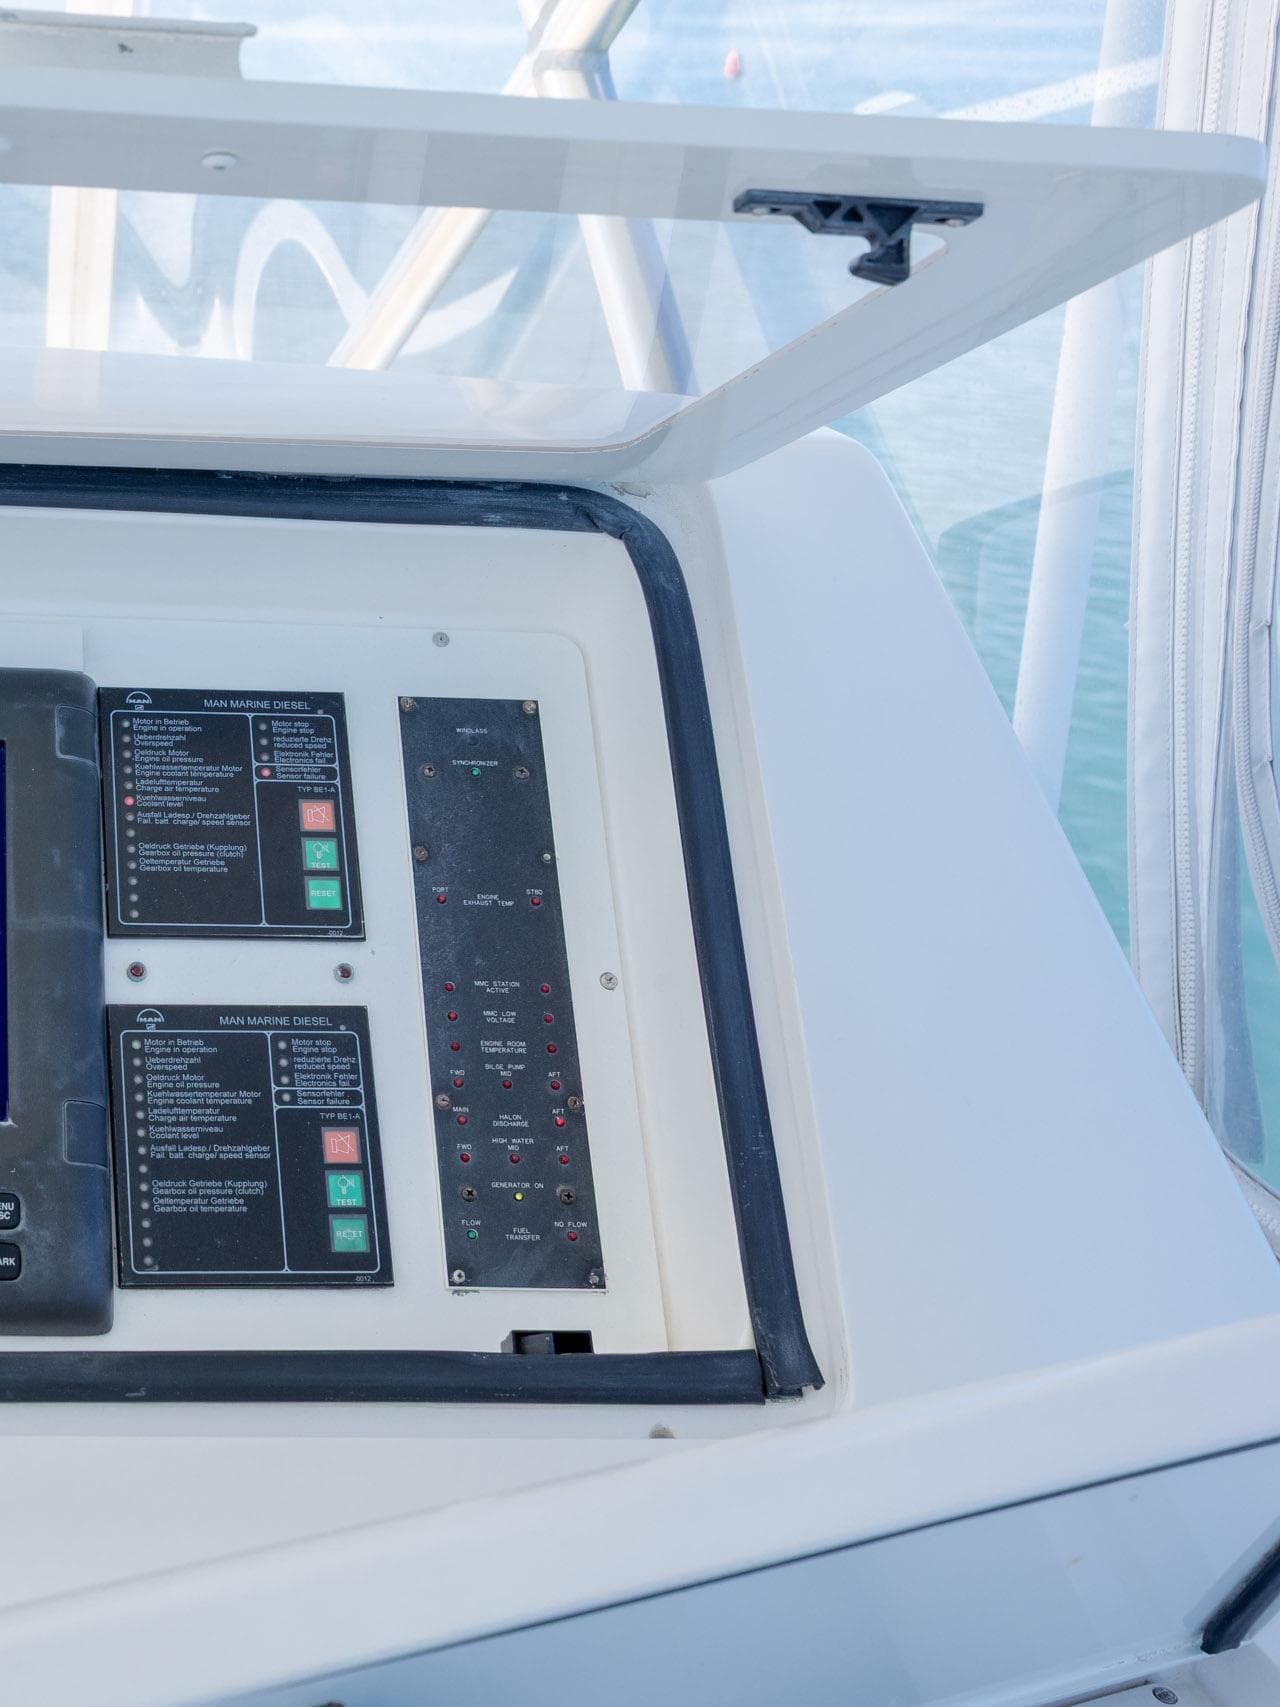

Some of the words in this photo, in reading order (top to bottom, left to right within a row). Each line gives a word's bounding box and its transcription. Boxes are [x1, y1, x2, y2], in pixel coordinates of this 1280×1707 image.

[204, 700, 227, 708] MAN
[230, 700, 271, 709] MARINE
[274, 701, 311, 710] DIESEL
[168, 725, 202, 733] operation
[272, 727, 298, 735] Engine
[299, 727, 314, 735] stop
[134, 740, 173, 748] Overspeed
[135, 755, 160, 763] Engine
[136, 785, 162, 793] Charge
[175, 786, 219, 794] temperature
[217, 850, 244, 858] (clutch)
[183, 866, 228, 874] temperature
[220, 1016, 244, 1025] MAN
[247, 1017, 290, 1025] MARINE
[293, 1017, 332, 1026] DIESEL
[315, 1039, 331, 1047] stop
[145, 1046, 171, 1054] Engine
[292, 1046, 319, 1054] Engine
[321, 1046, 337, 1054] stop
[146, 1063, 188, 1071] Overspeed
[327, 1063, 350, 1071] speed
[147, 1081, 173, 1089] Engine
[148, 1098, 174, 1106] Engine
[206, 1098, 252, 1106] temperature
[148, 1115, 176, 1123] Charge
[190, 1115, 237, 1123] temperature
[214, 1145, 270, 1153] Drehzahlgeber
[220, 1152, 242, 1160] speed
[224, 1180, 267, 1188] (Kupplung)
[235, 1188, 264, 1196] (clutch)
[153, 1197, 208, 1206] Oeltemperatur
[200, 1205, 248, 1214] temperature
